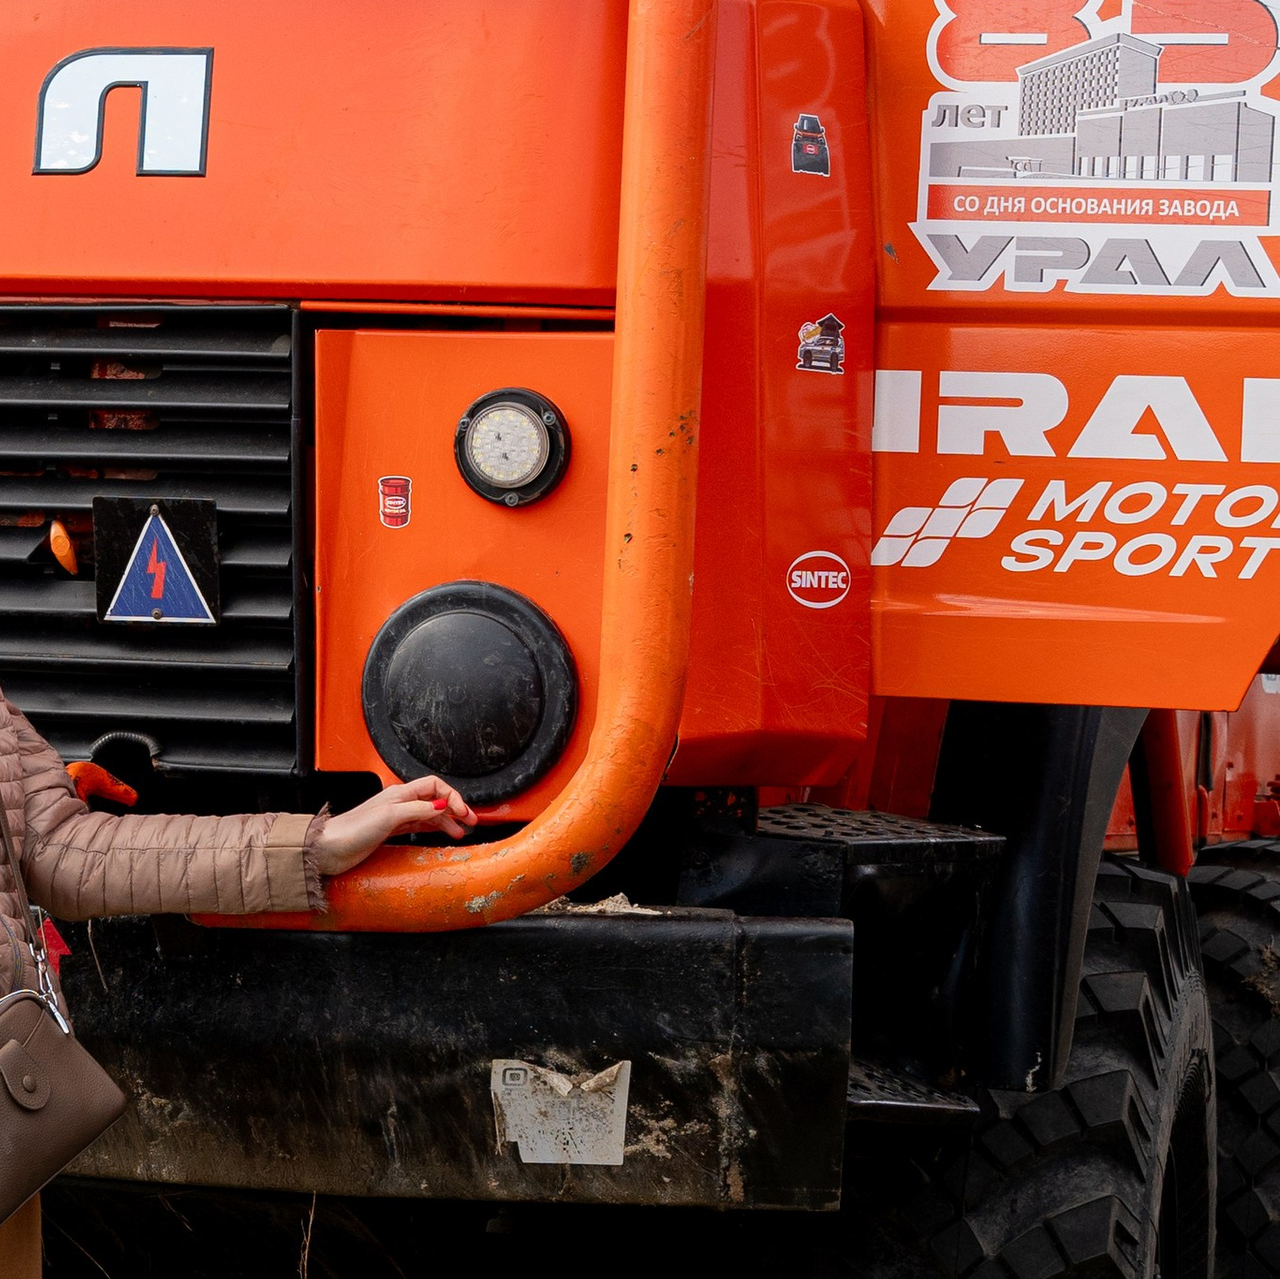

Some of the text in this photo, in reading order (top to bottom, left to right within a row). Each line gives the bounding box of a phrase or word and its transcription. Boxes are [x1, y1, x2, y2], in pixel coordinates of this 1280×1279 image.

[931, 103, 1009, 128] лет
[953, 196, 1240, 220] СО ДНЯ ОСНОВАНИЯ ЗАВОДА
[925, 233, 1267, 288] УРАЛ
[1026, 480, 1280, 529] MOTO
[1000, 529, 1280, 580] SPORT
[791, 569, 847, 589] SINTEC
